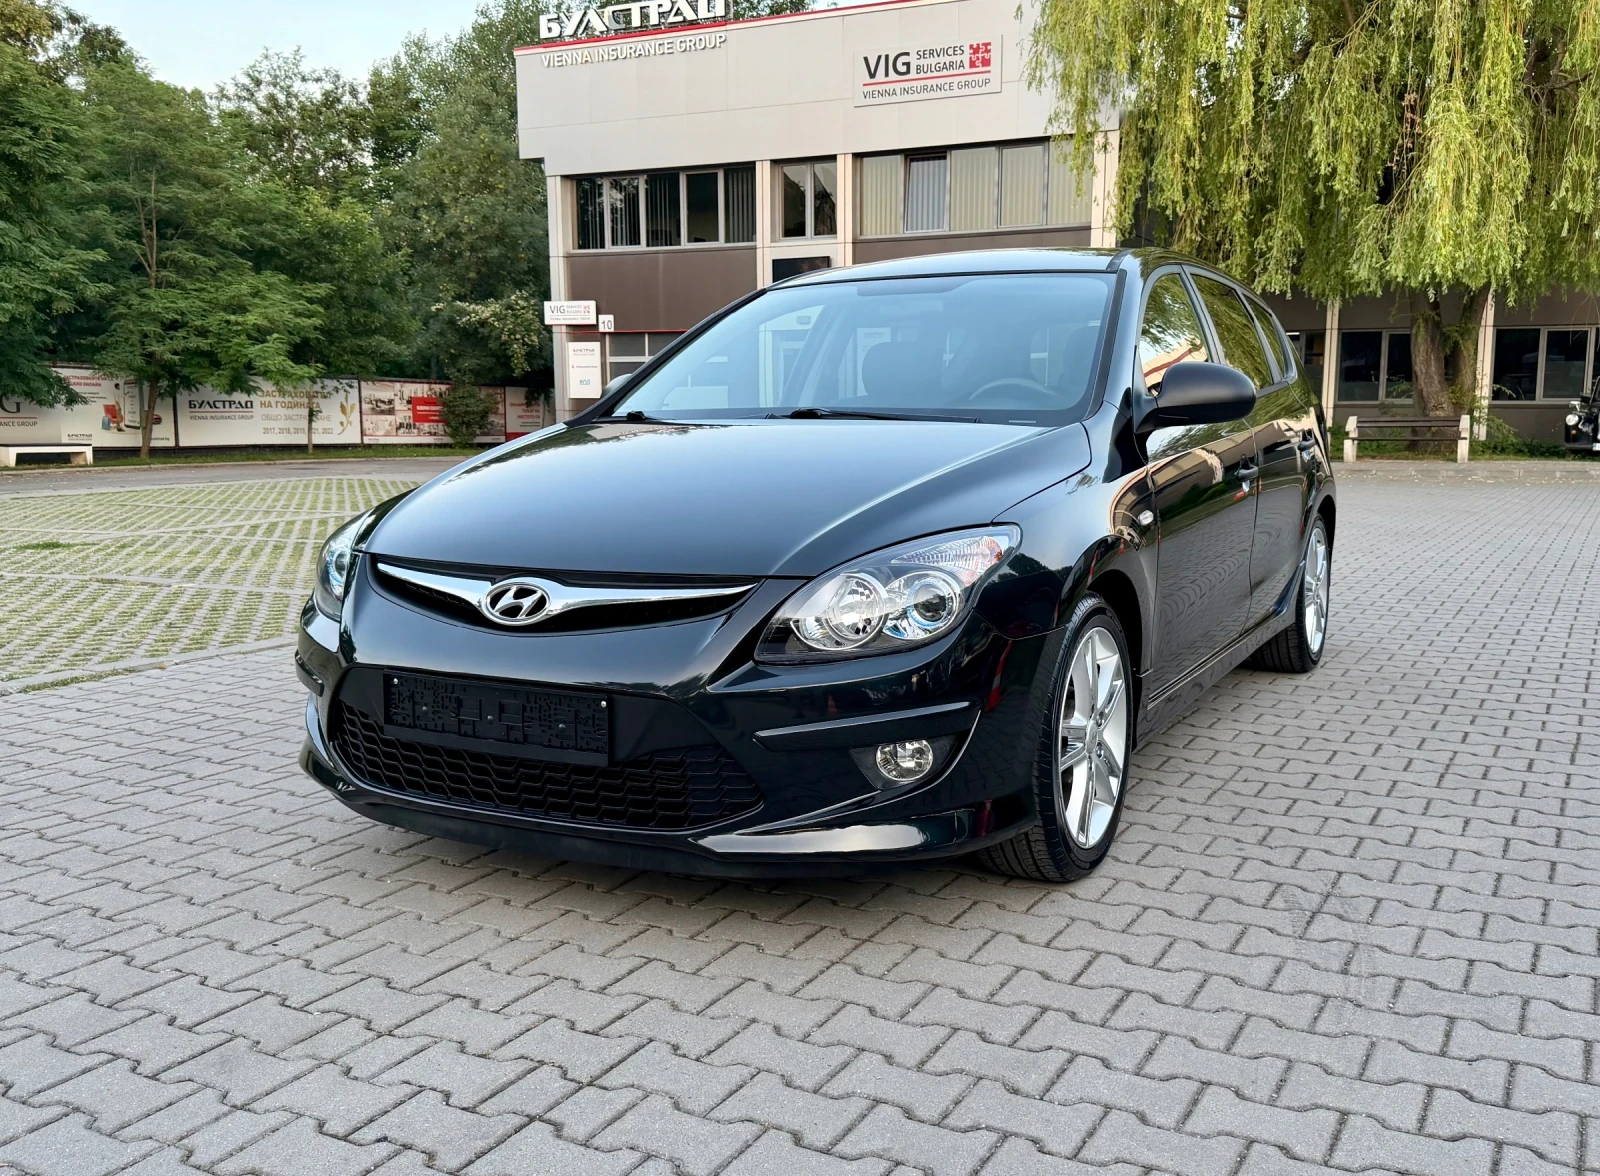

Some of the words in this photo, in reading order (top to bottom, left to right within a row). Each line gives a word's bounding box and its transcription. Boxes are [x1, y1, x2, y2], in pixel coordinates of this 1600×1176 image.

[541, 52, 593, 67] VIENNA
[595, 40, 674, 62] INSURANCE
[677, 33, 727, 52] GROUP
[916, 45, 965, 60] SERVICES
[863, 51, 911, 79] VIG
[915, 60, 965, 75] BULGARIA
[862, 87, 898, 100] VIENNA
[899, 82, 955, 96] INSURANCE
[957, 78, 991, 90] GROUP
[549, 305, 566, 314] VIG
[601, 319, 613, 330] 10
[188, 400, 254, 409] БУЛСТРАД
[260, 400, 273, 409] НА
[275, 400, 321, 410] ГОДИНАТА
[261, 413, 282, 422] ОБЩО
